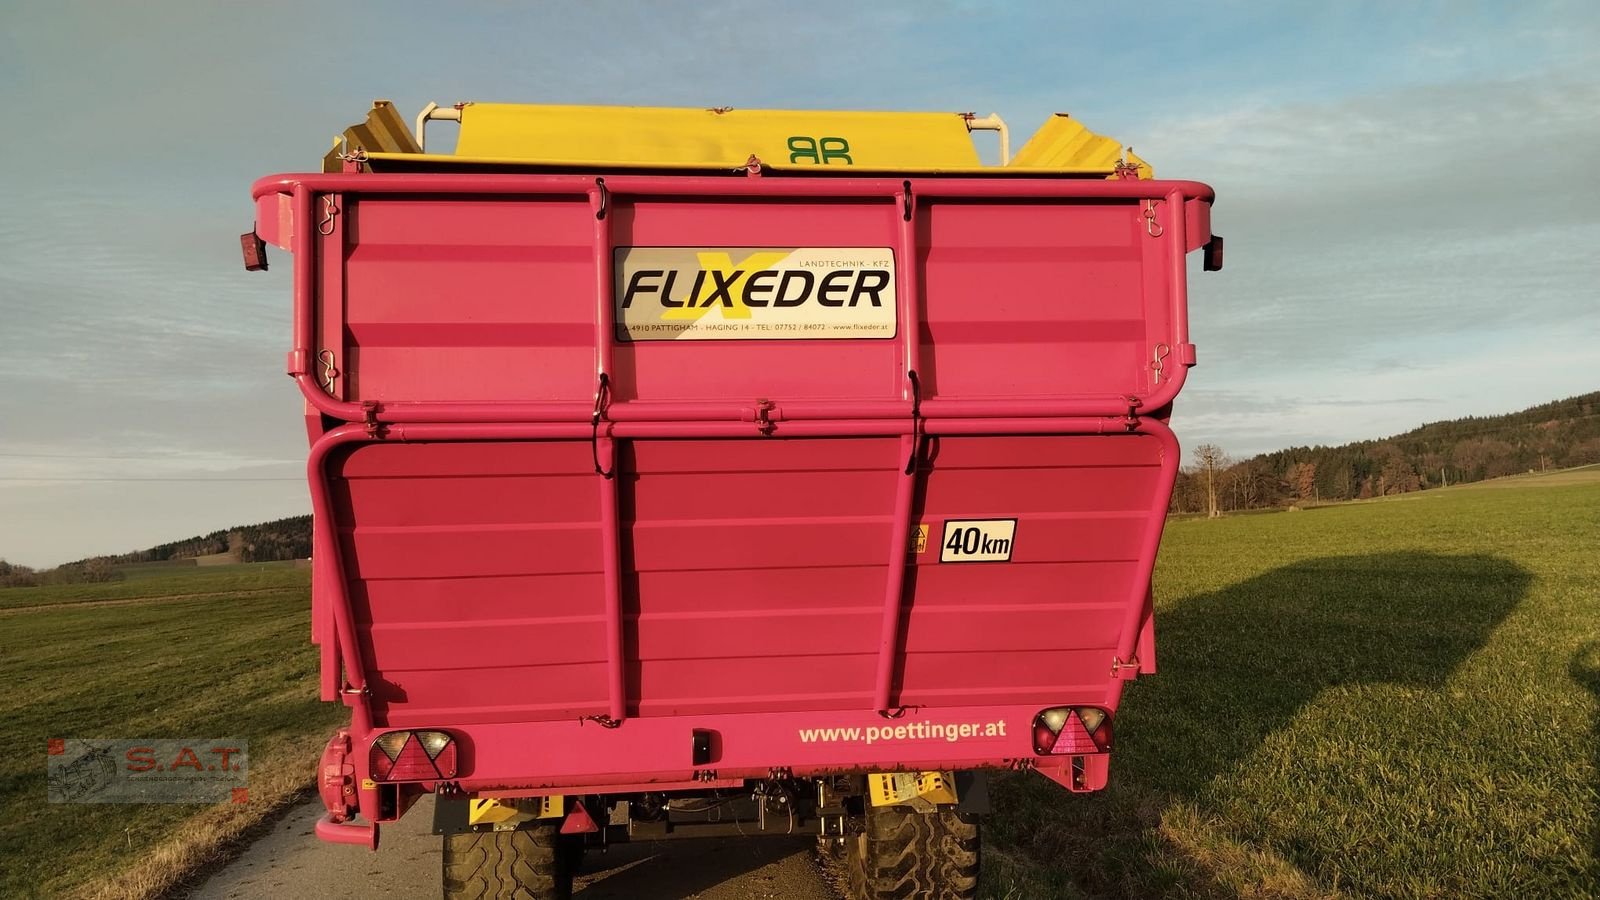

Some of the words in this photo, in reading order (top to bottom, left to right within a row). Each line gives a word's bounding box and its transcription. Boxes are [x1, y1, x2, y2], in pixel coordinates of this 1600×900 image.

[799, 260, 865, 268] LANDTECHNIK
[872, 260, 889, 268] KFZ
[621, 269, 890, 309] FLIXEDER
[651, 323, 698, 333] PATTIGHAM
[705, 323, 739, 332] HAGING
[741, 323, 749, 332] 14
[756, 323, 772, 331] TEL:
[774, 323, 796, 331] 07752
[803, 323, 825, 331] 84072
[832, 323, 888, 331] www.flixeder.at
[799, 719, 1007, 745] www.poettinger.at
